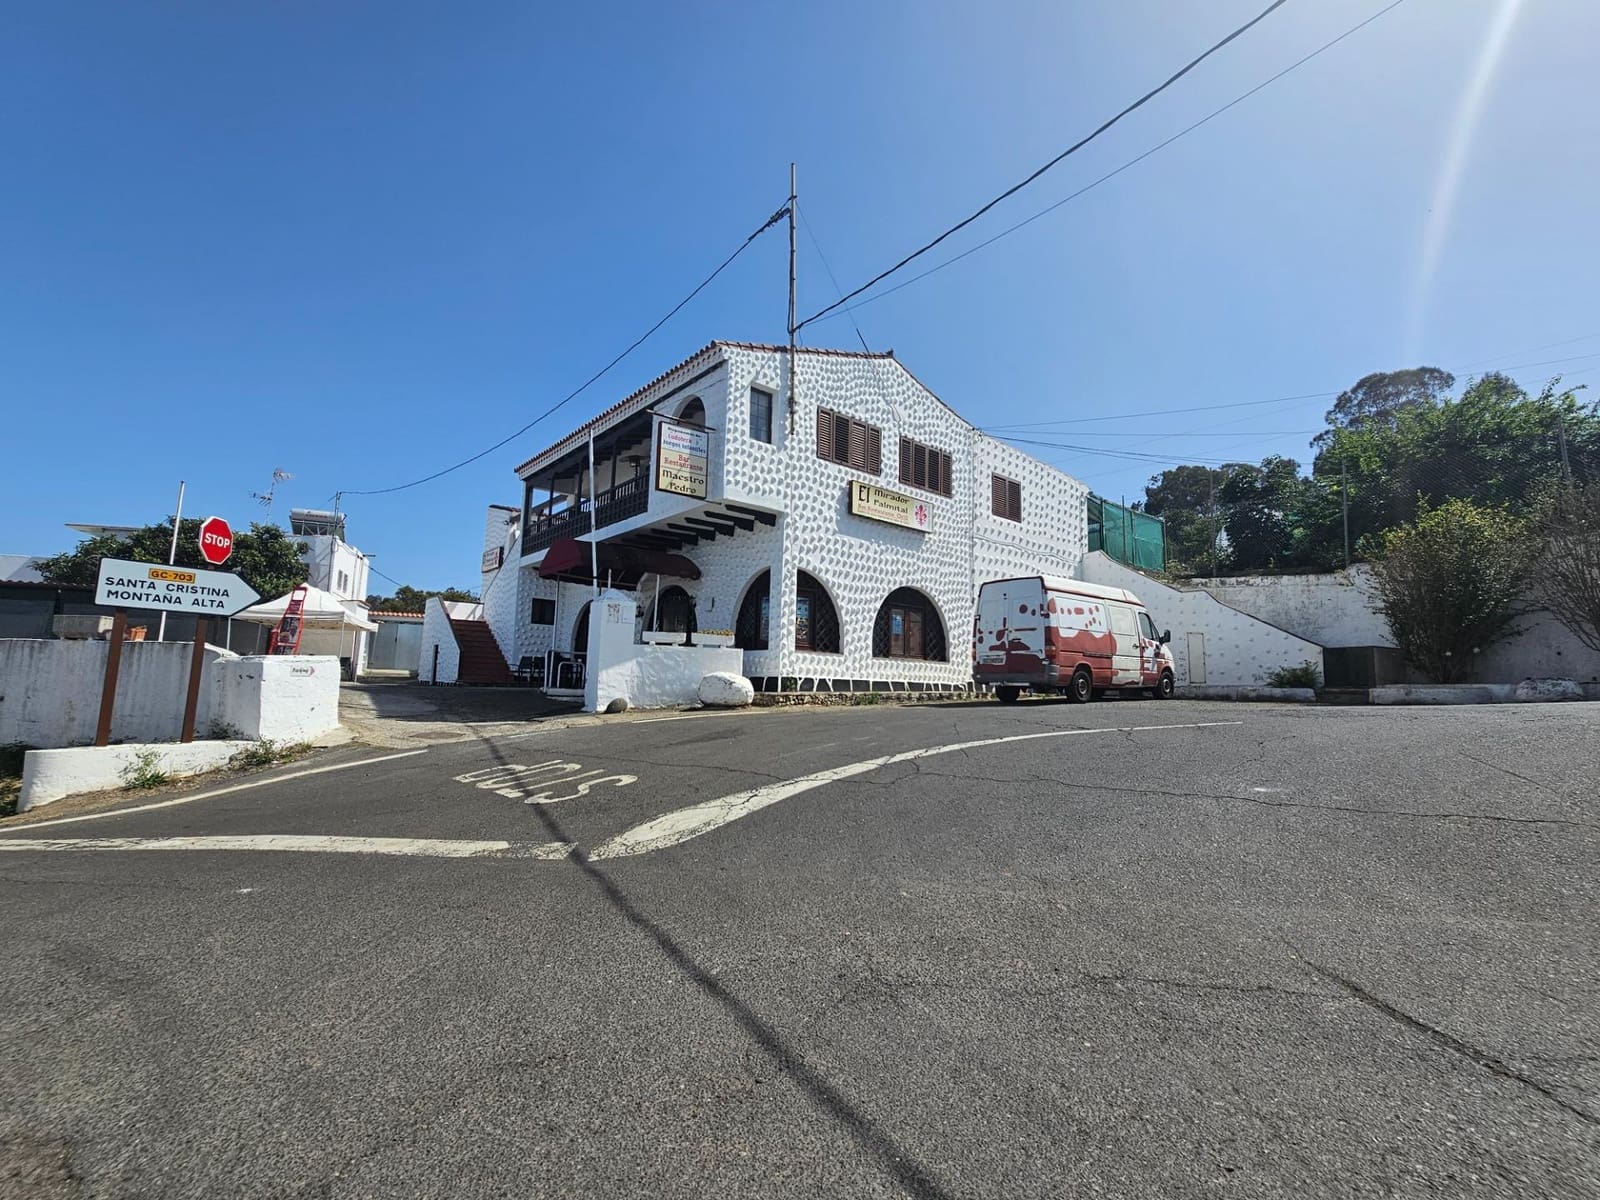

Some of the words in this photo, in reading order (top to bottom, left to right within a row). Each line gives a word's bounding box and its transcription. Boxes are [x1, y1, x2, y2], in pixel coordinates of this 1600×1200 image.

[678, 454, 690, 463] Bar
[663, 470, 704, 484] Maestro
[669, 482, 697, 494] Pedro
[859, 485, 871, 503] El
[875, 488, 909, 504] Mirador
[873, 499, 908, 514] Palmital
[204, 532, 231, 549] STOP
[150, 570, 193, 582] GC-703
[105, 577, 156, 591] SANTA
[166, 583, 230, 598] CRISTINA
[107, 590, 182, 605] MONTAÑA
[191, 598, 225, 609] ALTA
[452, 759, 639, 805] STOP
